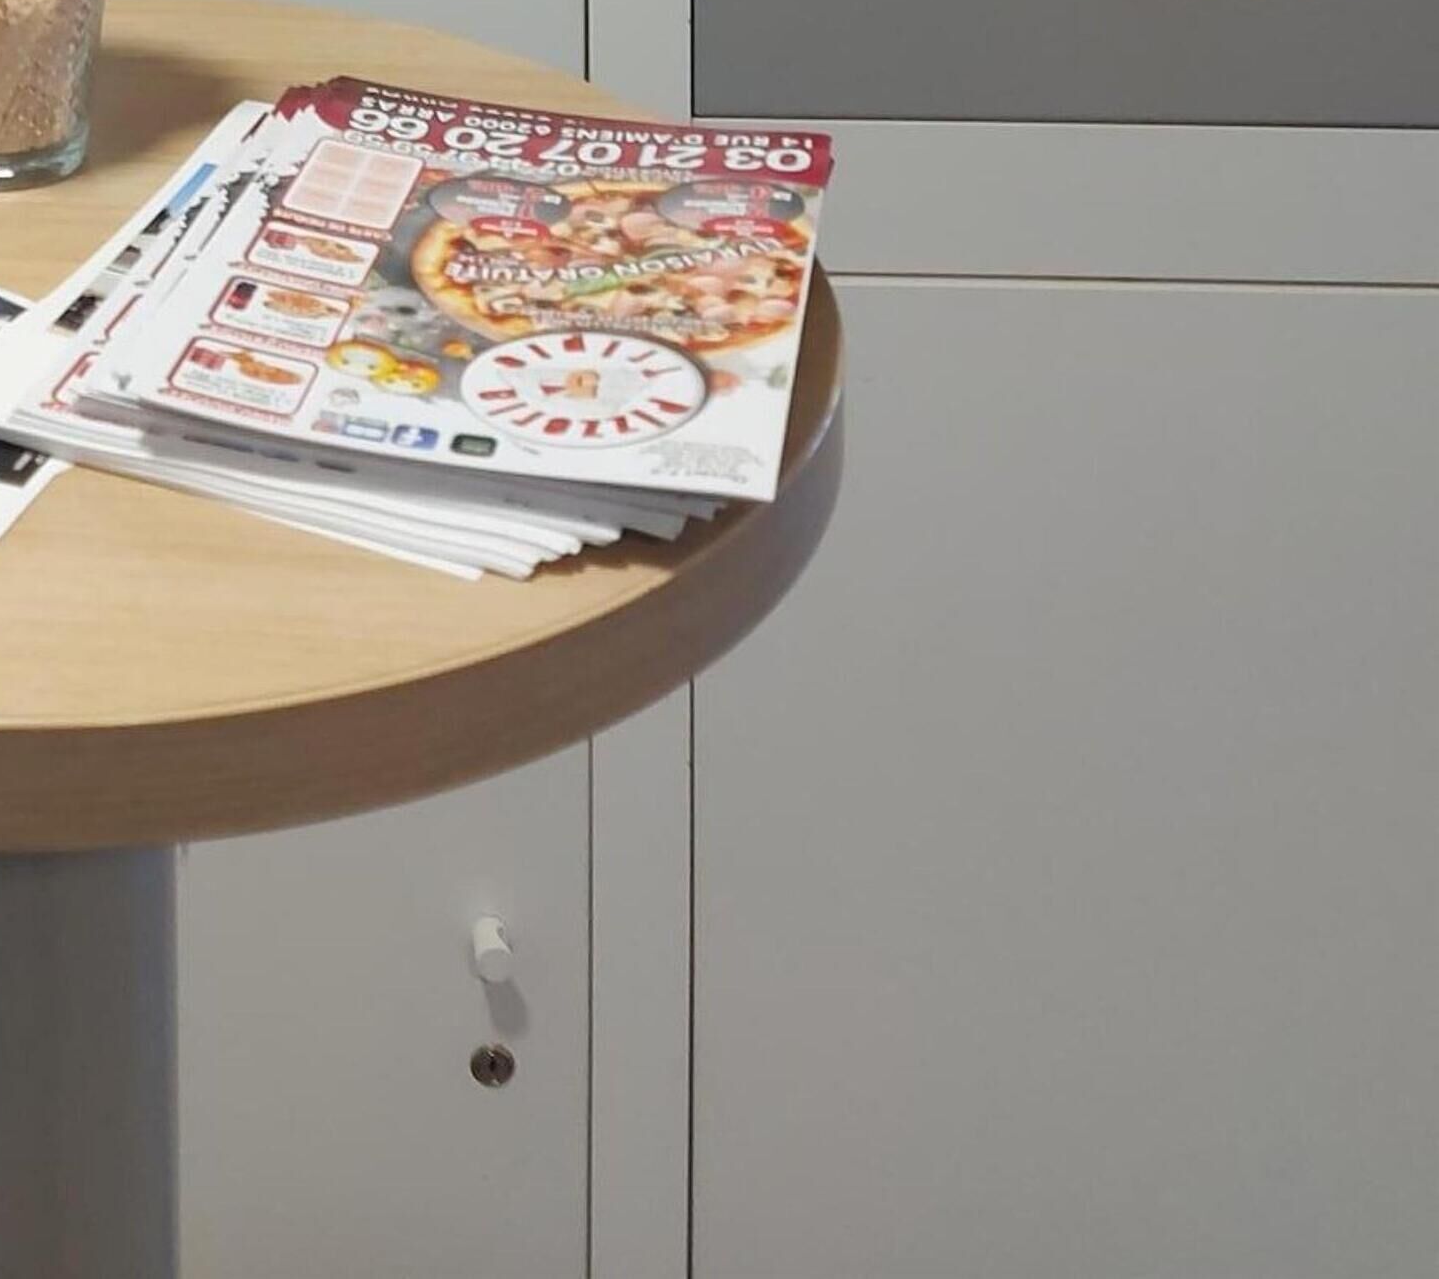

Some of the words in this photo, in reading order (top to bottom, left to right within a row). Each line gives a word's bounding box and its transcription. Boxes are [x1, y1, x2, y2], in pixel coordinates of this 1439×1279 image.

[362, 94, 445, 122] ARRAS
[348, 107, 429, 141] 66
[464, 115, 551, 137] 62000
[561, 126, 700, 146] D'AMIENS
[443, 126, 529, 155] 20
[544, 137, 624, 165] 07
[715, 132, 772, 148] RUE
[639, 143, 705, 169] 21
[724, 148, 812, 174] 03
[613, 239, 782, 276] LIVRAISON
[446, 258, 605, 284] GRATUITE
